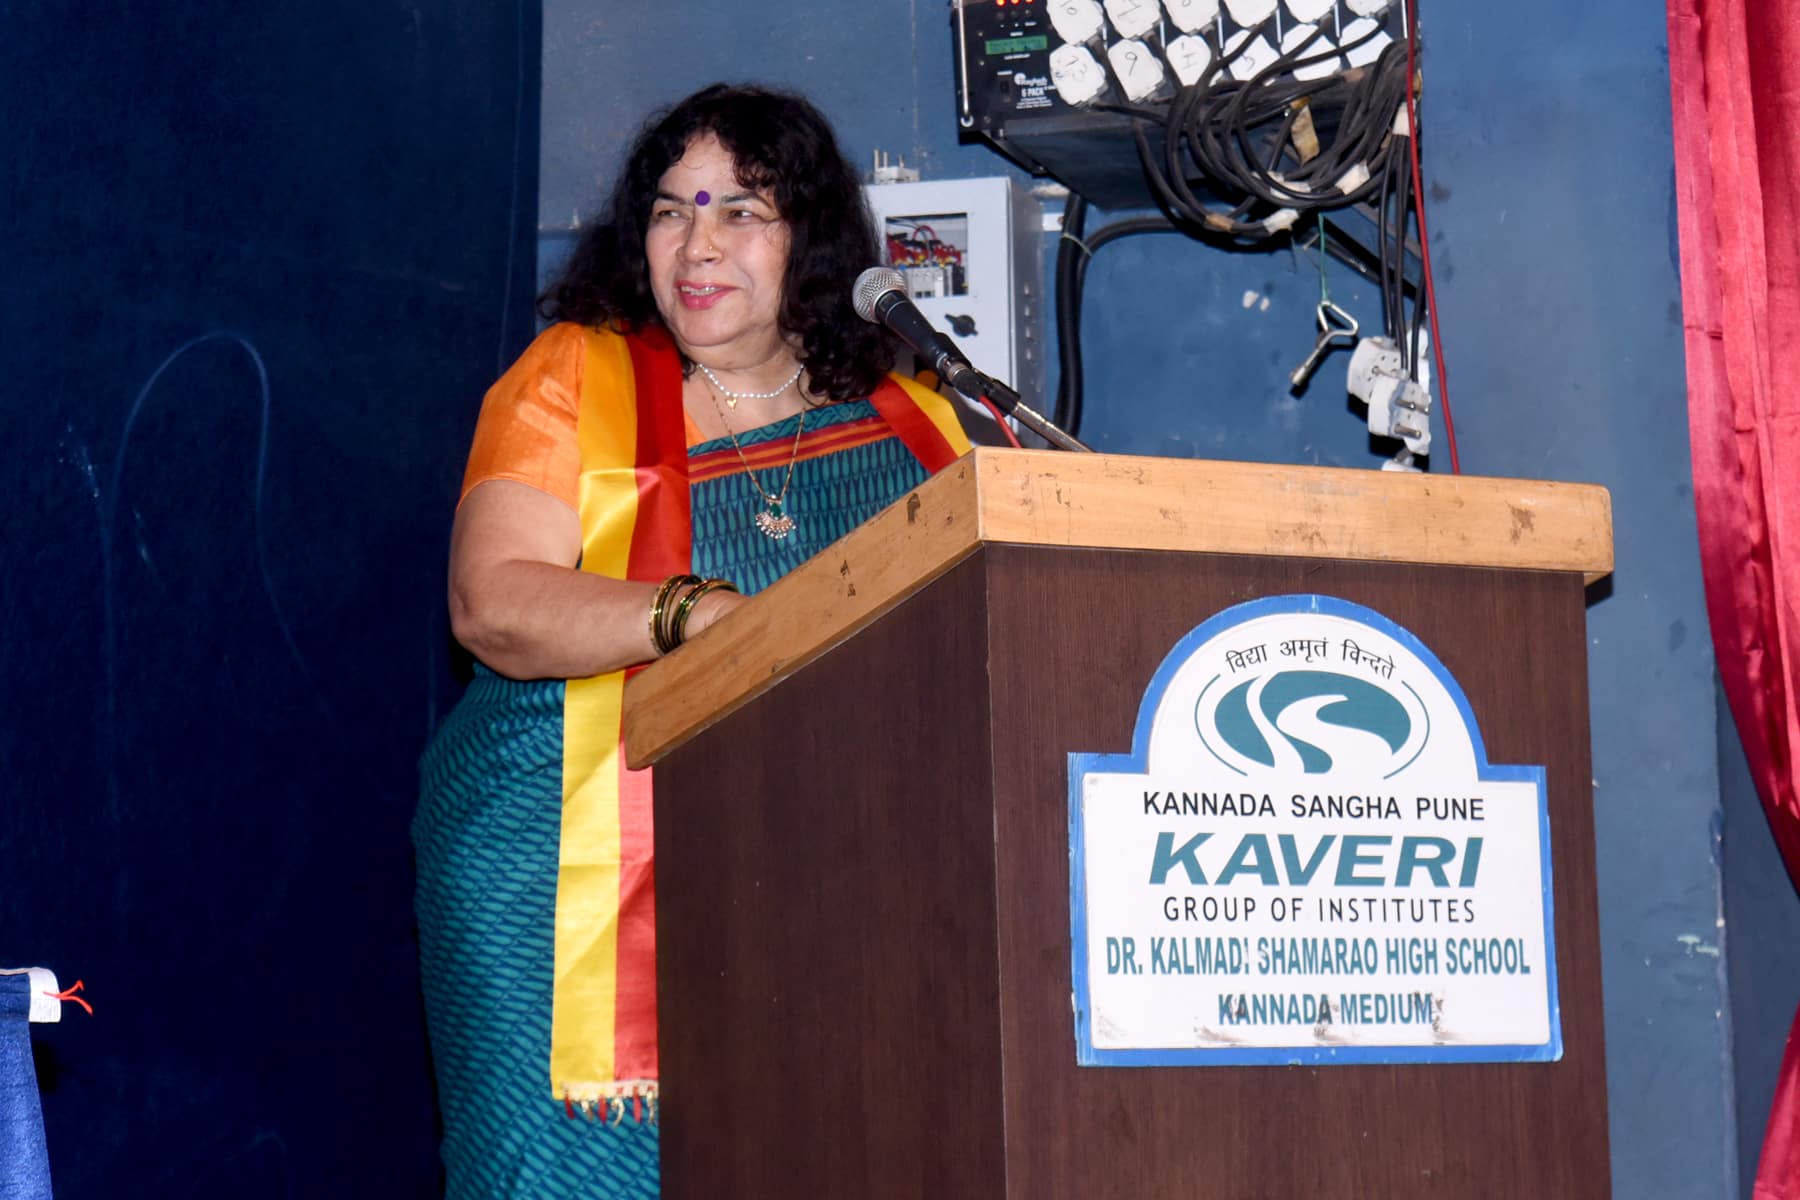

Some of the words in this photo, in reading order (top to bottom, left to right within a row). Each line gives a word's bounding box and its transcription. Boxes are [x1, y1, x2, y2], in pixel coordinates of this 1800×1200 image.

[1226, 645, 1267, 673] विद्या
[1279, 637, 1329, 663] अमृतं
[1341, 638, 1396, 680] विन्दते
[1143, 791, 1277, 817] KANNADA
[1291, 794, 1402, 820] SANGHA
[1416, 796, 1485, 821] PUNE
[1149, 831, 1484, 888] KAVERI
[1163, 896, 1256, 922] GROUP
[1270, 897, 1304, 923] OF
[1318, 897, 1475, 923] INSTITUTES
[1106, 936, 1143, 975] DR.
[1257, 936, 1379, 975] SHAMARAO
[1385, 937, 1439, 976] HIGH
[1445, 937, 1531, 975] SCHOOL
[1218, 993, 1333, 1025] KANNADA
[1340, 993, 1433, 1026] MEDIUM
